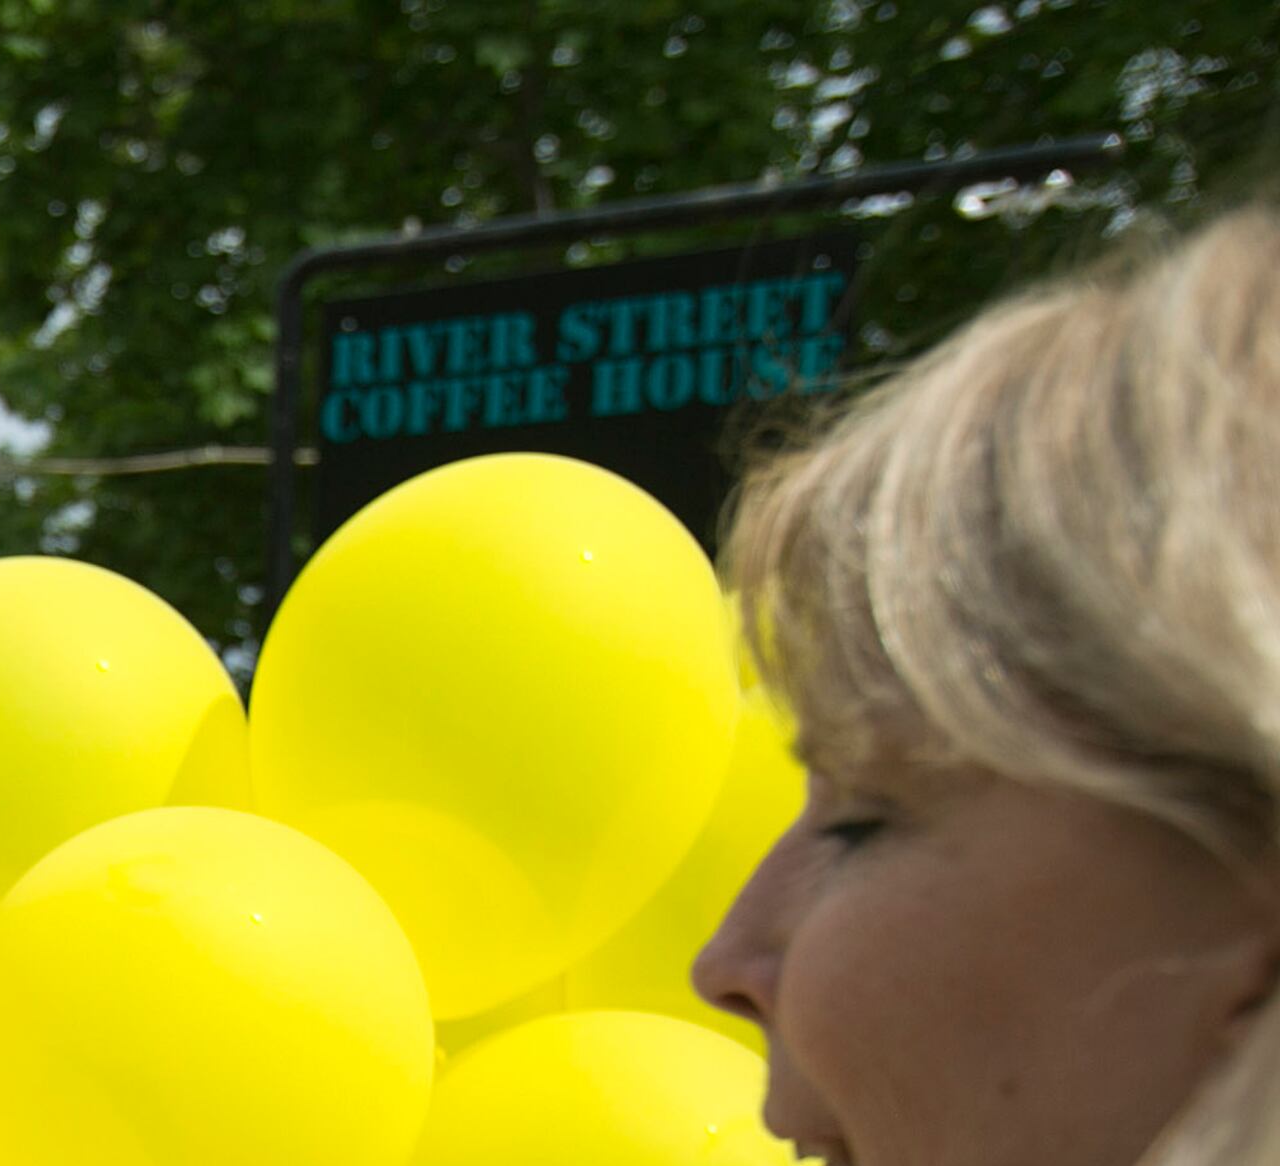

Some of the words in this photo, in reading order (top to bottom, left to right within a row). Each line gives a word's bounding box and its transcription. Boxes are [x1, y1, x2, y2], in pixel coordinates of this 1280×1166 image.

[331, 310, 537, 390] RIVER
[556, 271, 845, 364] STREET
[320, 364, 570, 444] COFFEE
[590, 335, 844, 418] HOUSE
